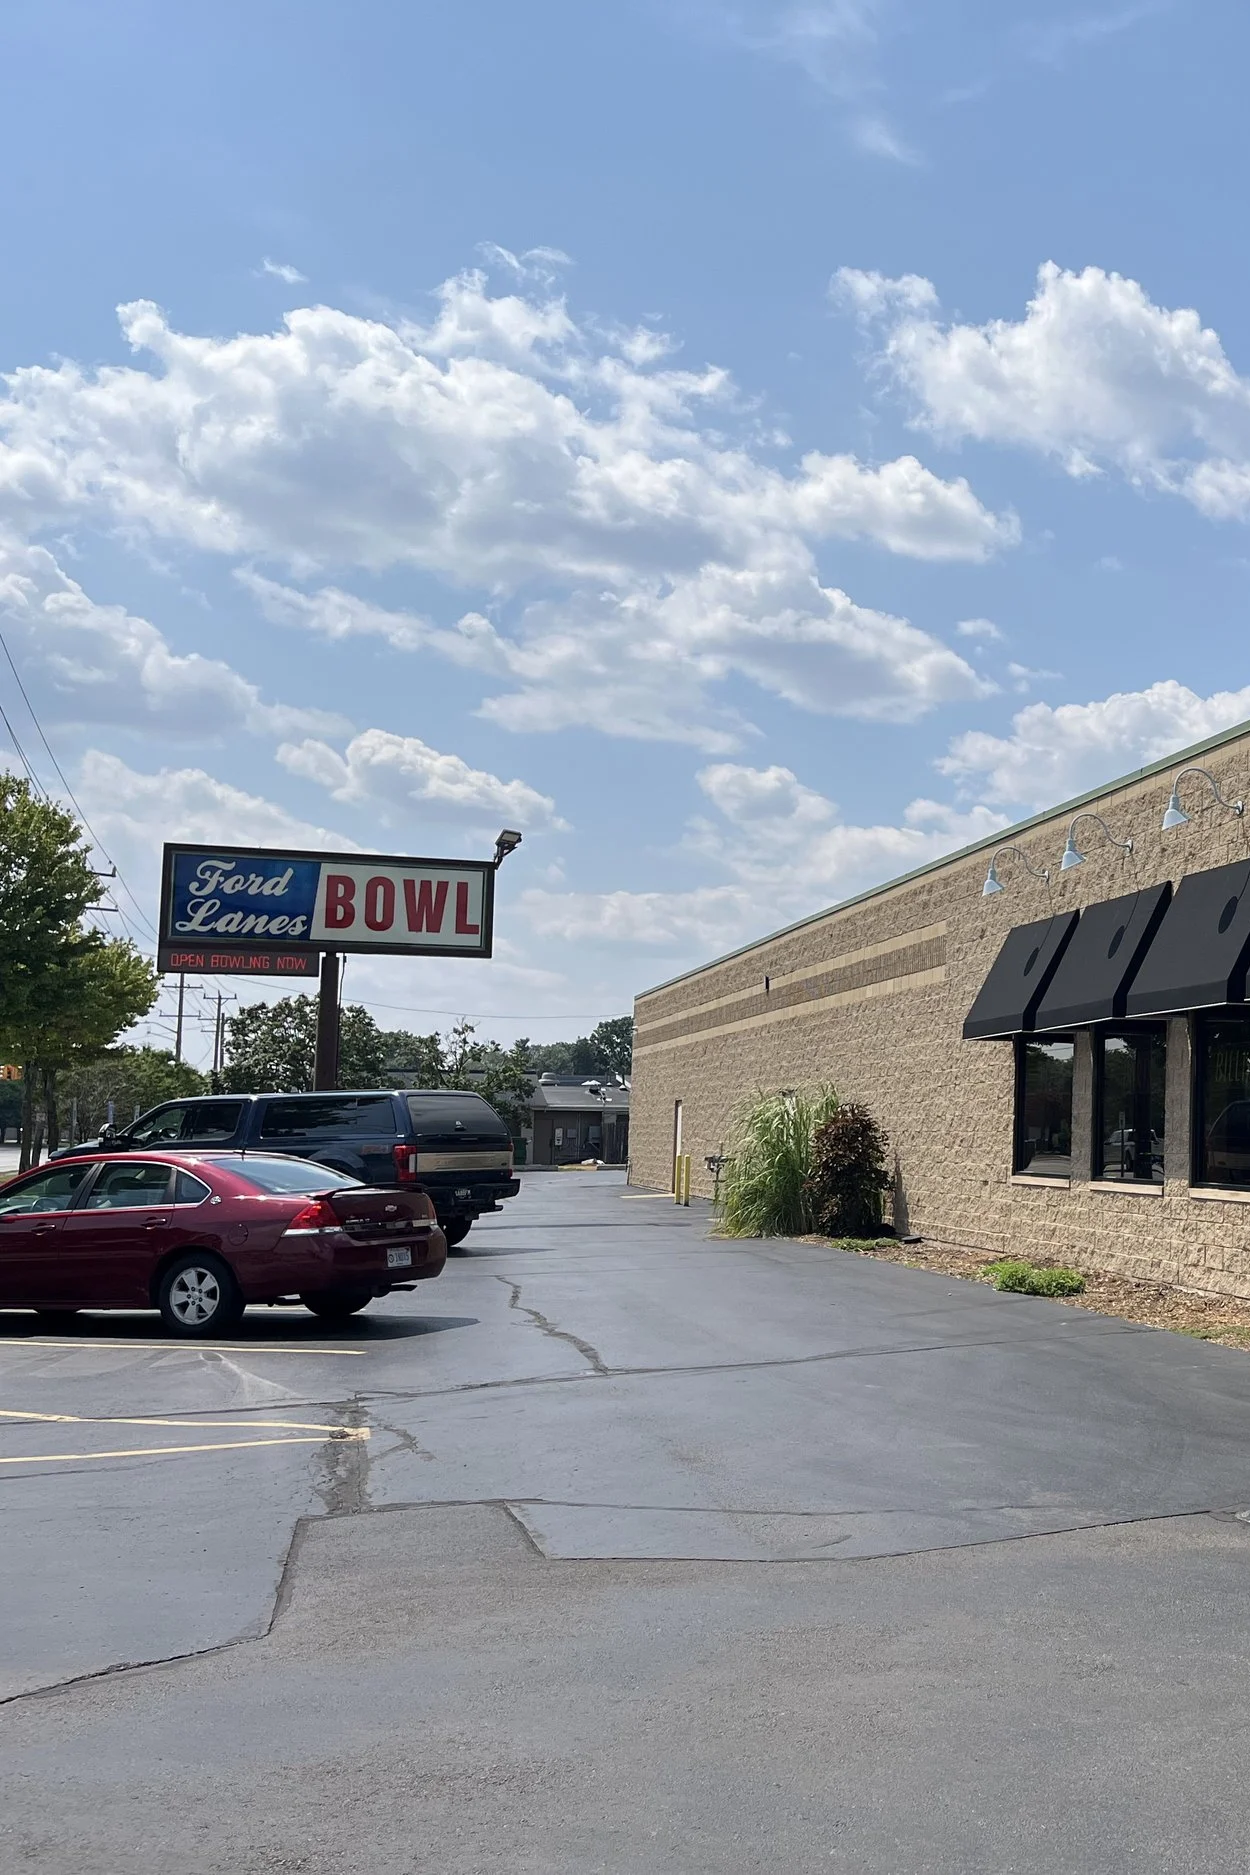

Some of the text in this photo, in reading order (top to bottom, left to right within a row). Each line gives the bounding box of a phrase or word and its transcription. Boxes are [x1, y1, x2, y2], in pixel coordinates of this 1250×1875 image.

[188, 860, 294, 897] Ford
[175, 899, 307, 936] Lanes
[324, 874, 480, 935] BOWL
[170, 953, 307, 970] OPEN BOWLING NOW
